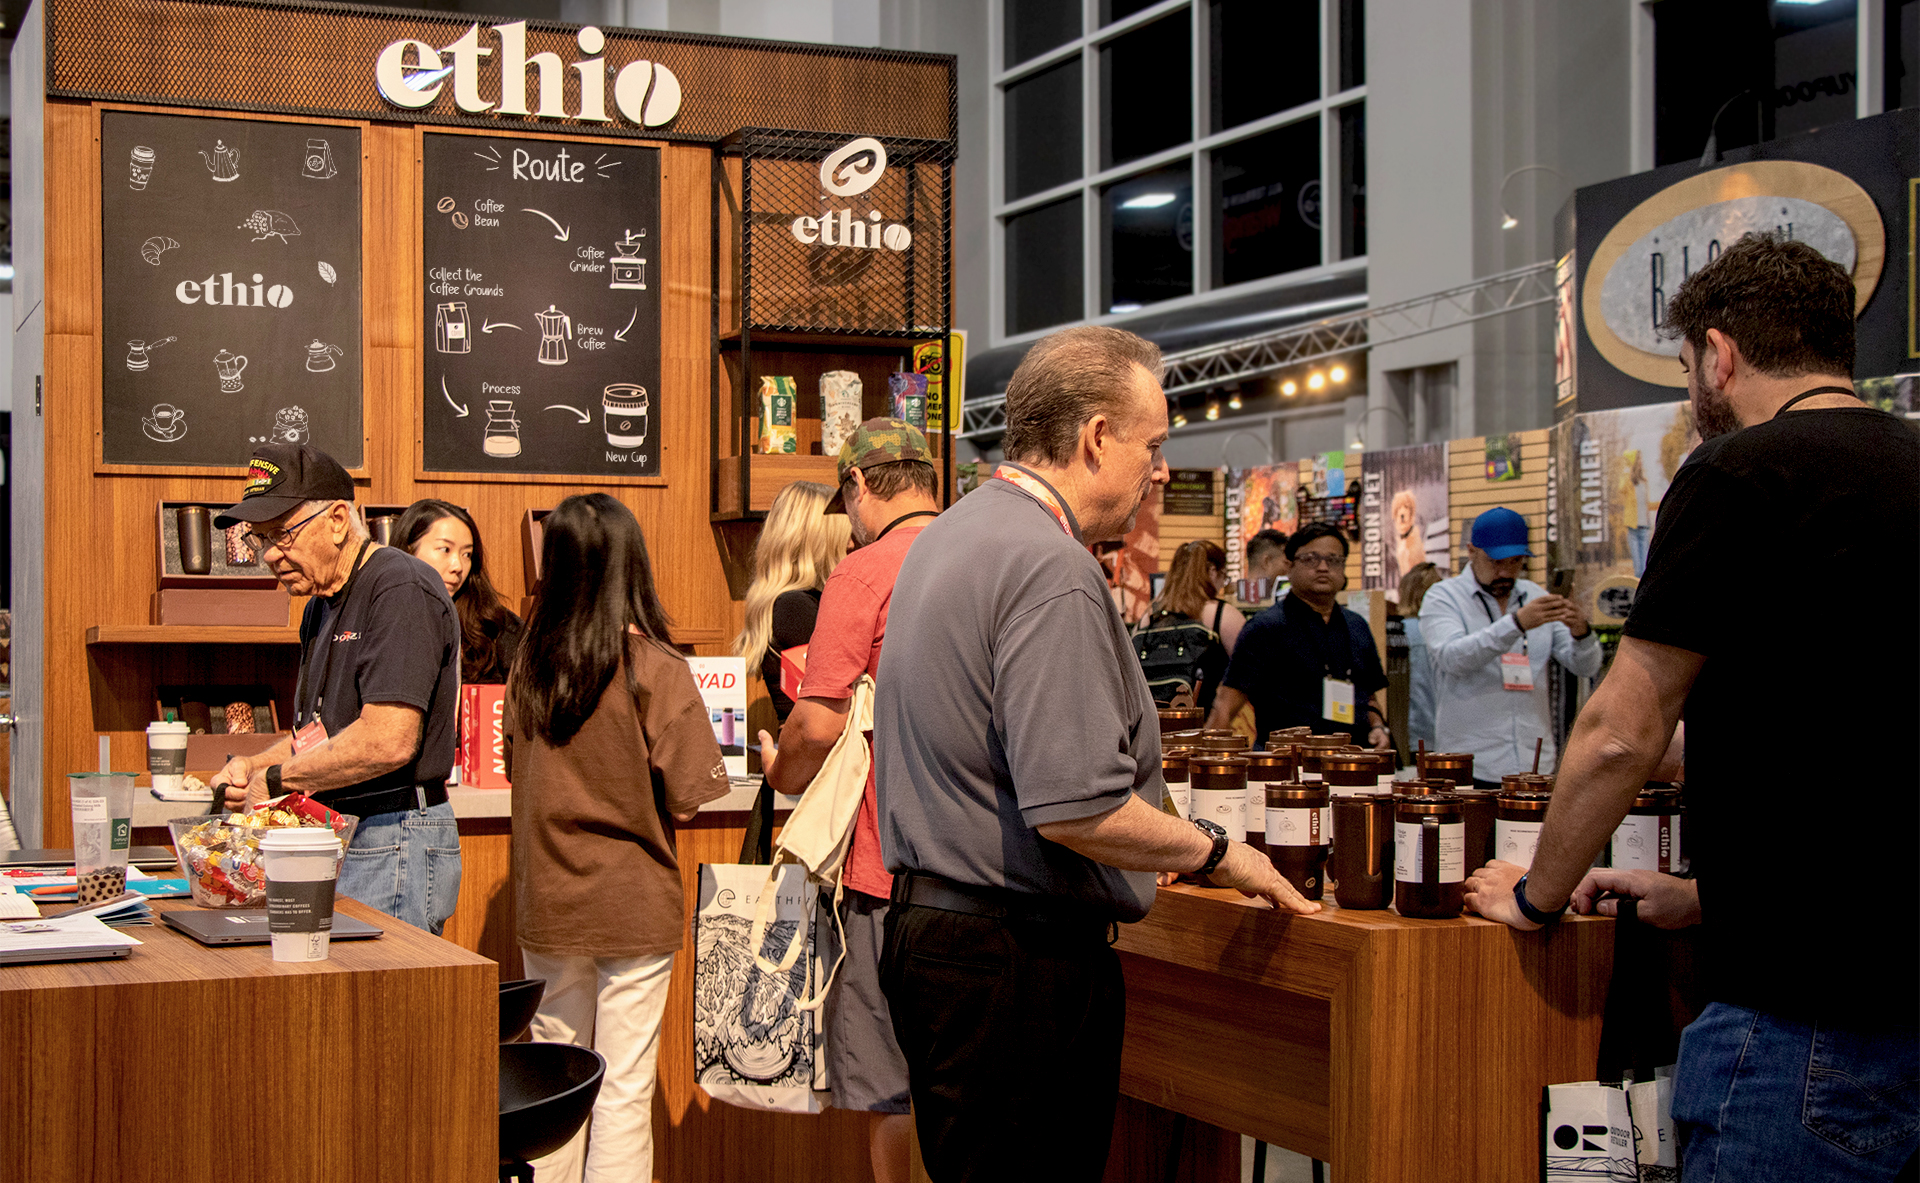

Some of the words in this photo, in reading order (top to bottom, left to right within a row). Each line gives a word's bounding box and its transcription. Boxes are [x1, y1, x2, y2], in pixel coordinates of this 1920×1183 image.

[376, 20, 682, 127] ethio
[513, 148, 585, 183] Route
[474, 199, 505, 213] Coffee
[474, 214, 500, 227] Bean
[792, 208, 912, 251] ethio
[577, 246, 605, 260] Coffee
[429, 267, 462, 283] Collect
[465, 268, 482, 282] the
[569, 261, 606, 273] Grinder
[175, 272, 294, 309] ethio
[429, 282, 460, 296] Coffee
[464, 282, 504, 297] Grounds
[577, 323, 604, 336] Brew
[577, 338, 606, 350] Coffee
[482, 382, 521, 395] Process
[605, 451, 627, 463] New
[631, 451, 648, 467] Cup
[1364, 472, 1381, 507] PET
[1580, 439, 1602, 544] LEATHER
[1226, 487, 1241, 519] PET
[1226, 523, 1241, 583] BISON
[1364, 513, 1381, 577] BISON
